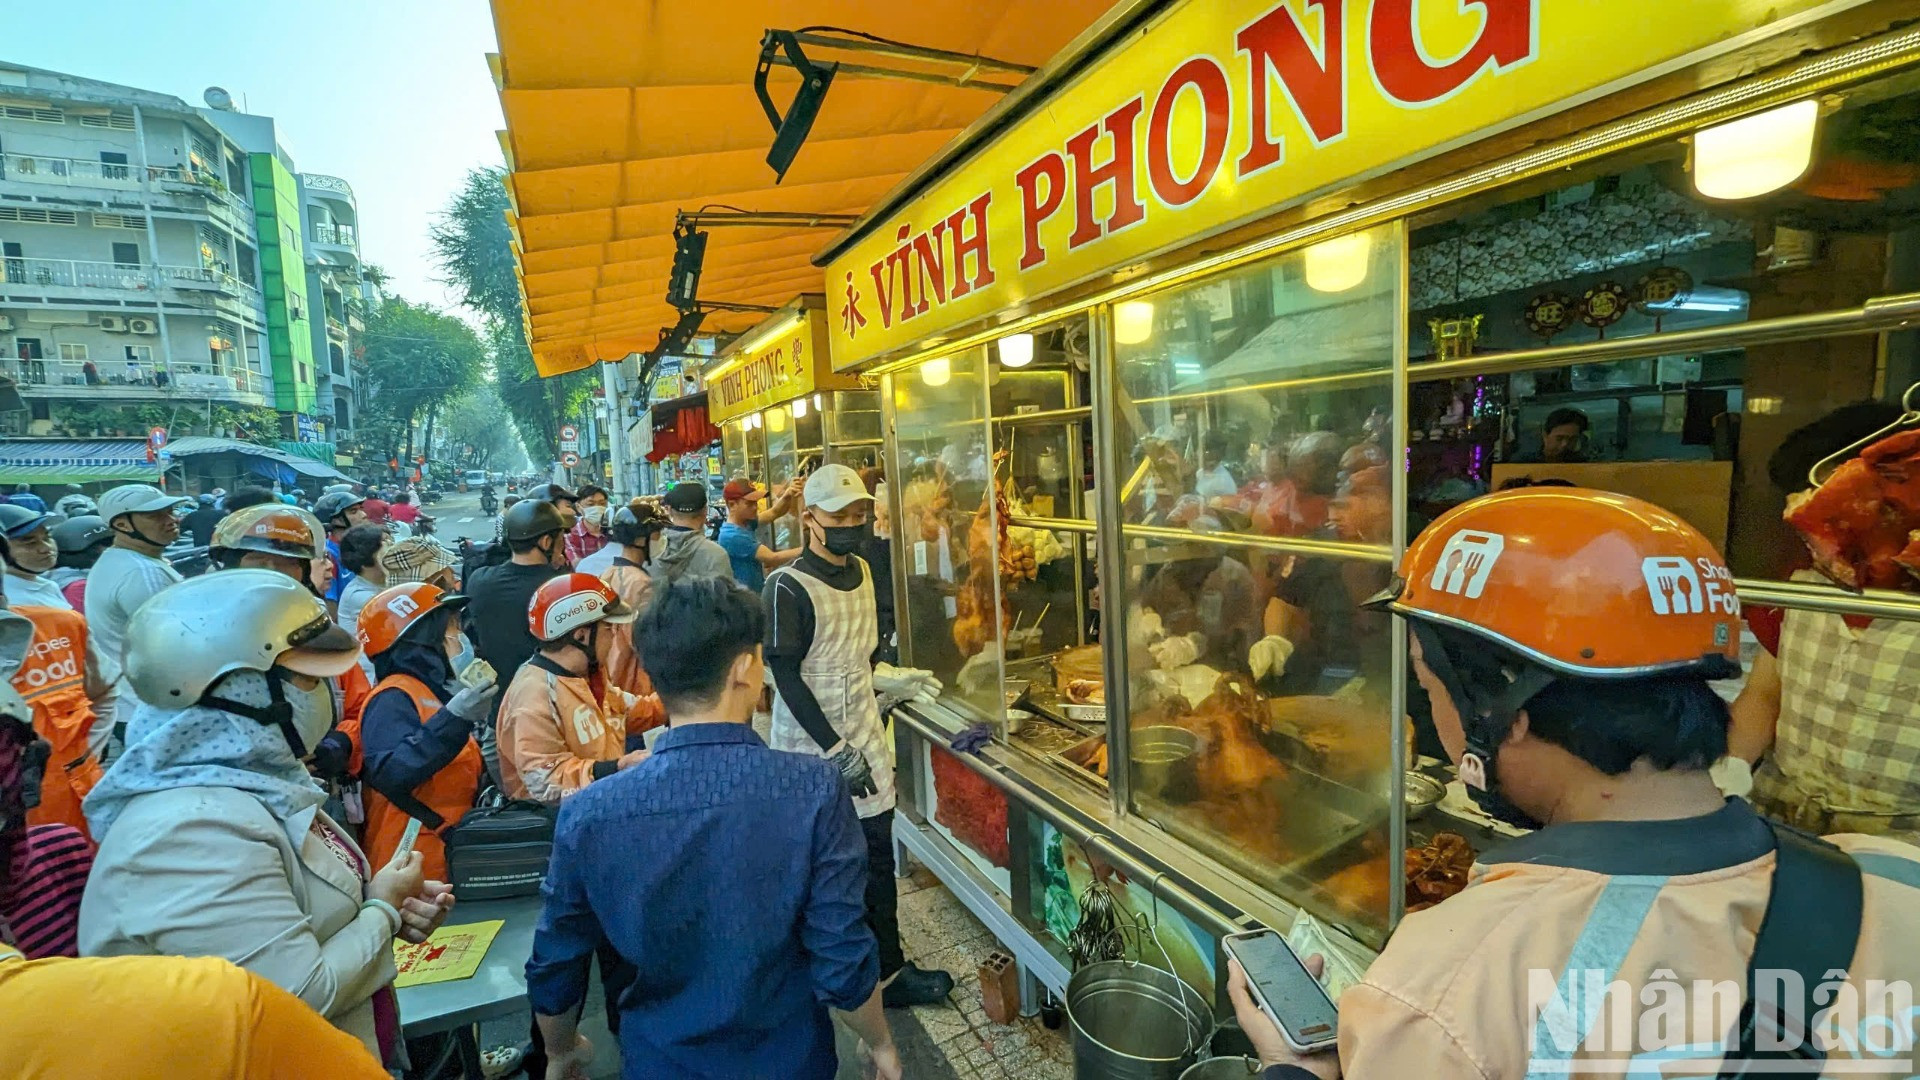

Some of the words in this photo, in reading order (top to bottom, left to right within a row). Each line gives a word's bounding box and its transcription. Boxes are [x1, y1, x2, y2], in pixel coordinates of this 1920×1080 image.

[871, 191, 996, 330] VĨNH
[1015, 0, 1540, 271] PHONG
[842, 271, 867, 340] 永
[744, 348, 786, 398] PHONG
